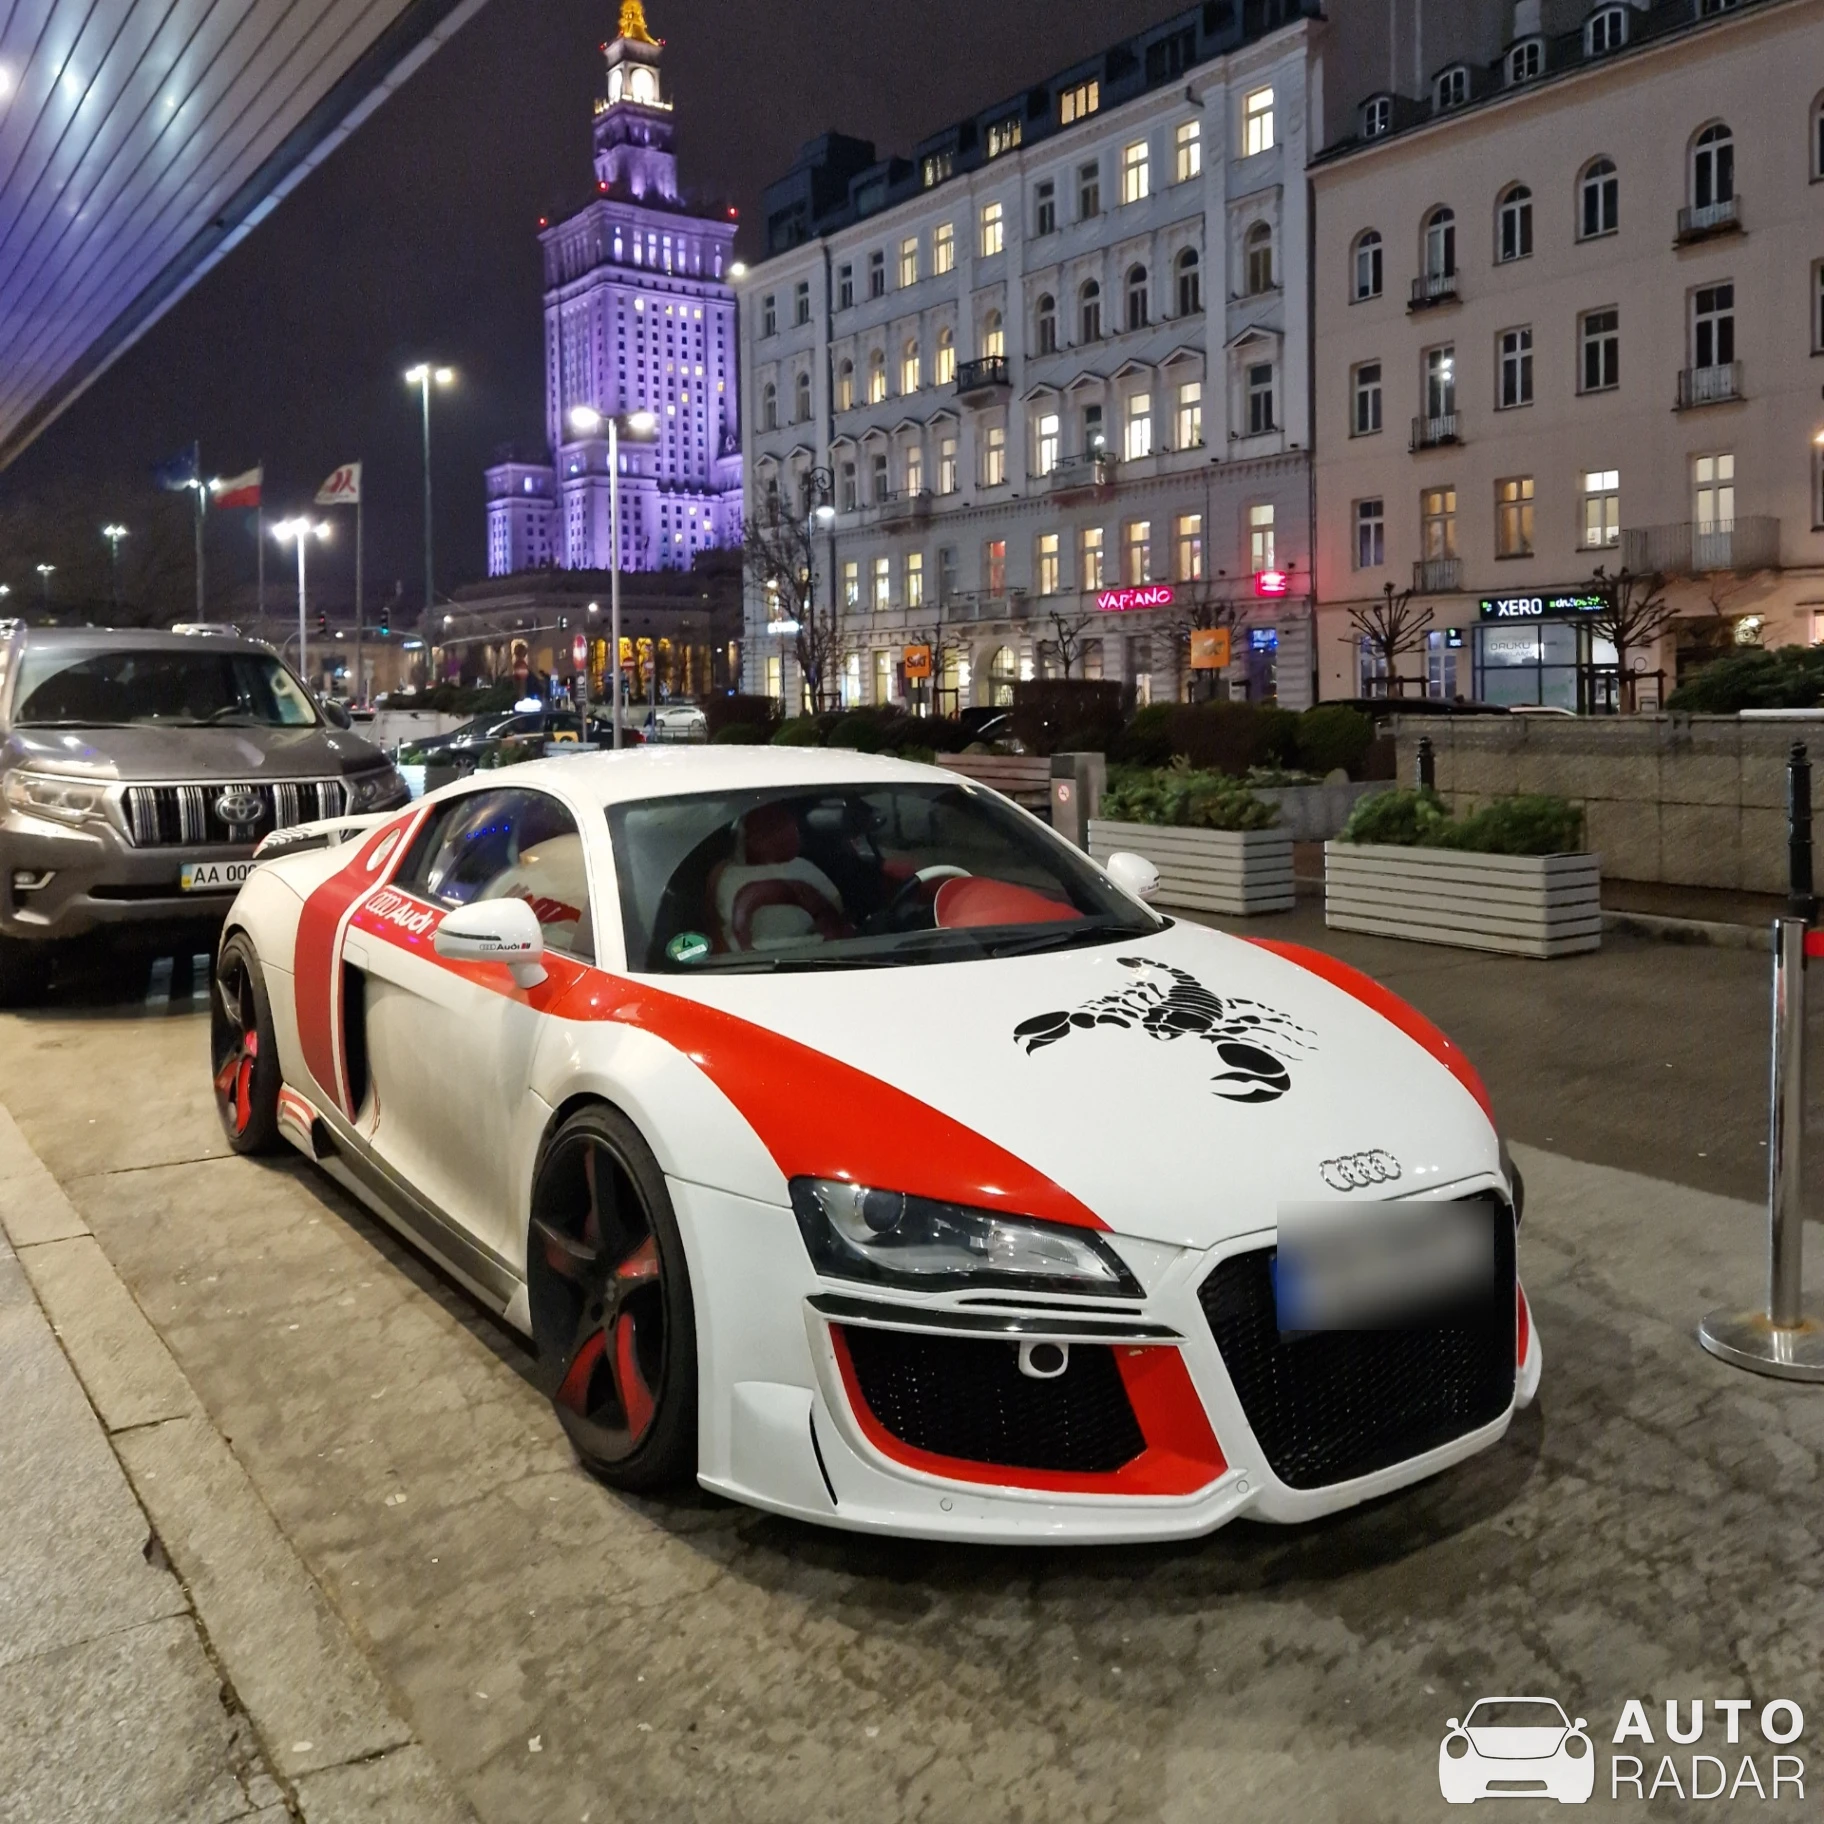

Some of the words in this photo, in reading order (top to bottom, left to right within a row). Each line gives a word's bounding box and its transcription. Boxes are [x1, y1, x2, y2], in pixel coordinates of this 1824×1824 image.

[1497, 598, 1542, 616] XERO
[194, 866, 220, 884] AA
[384, 901, 434, 935] Audi
